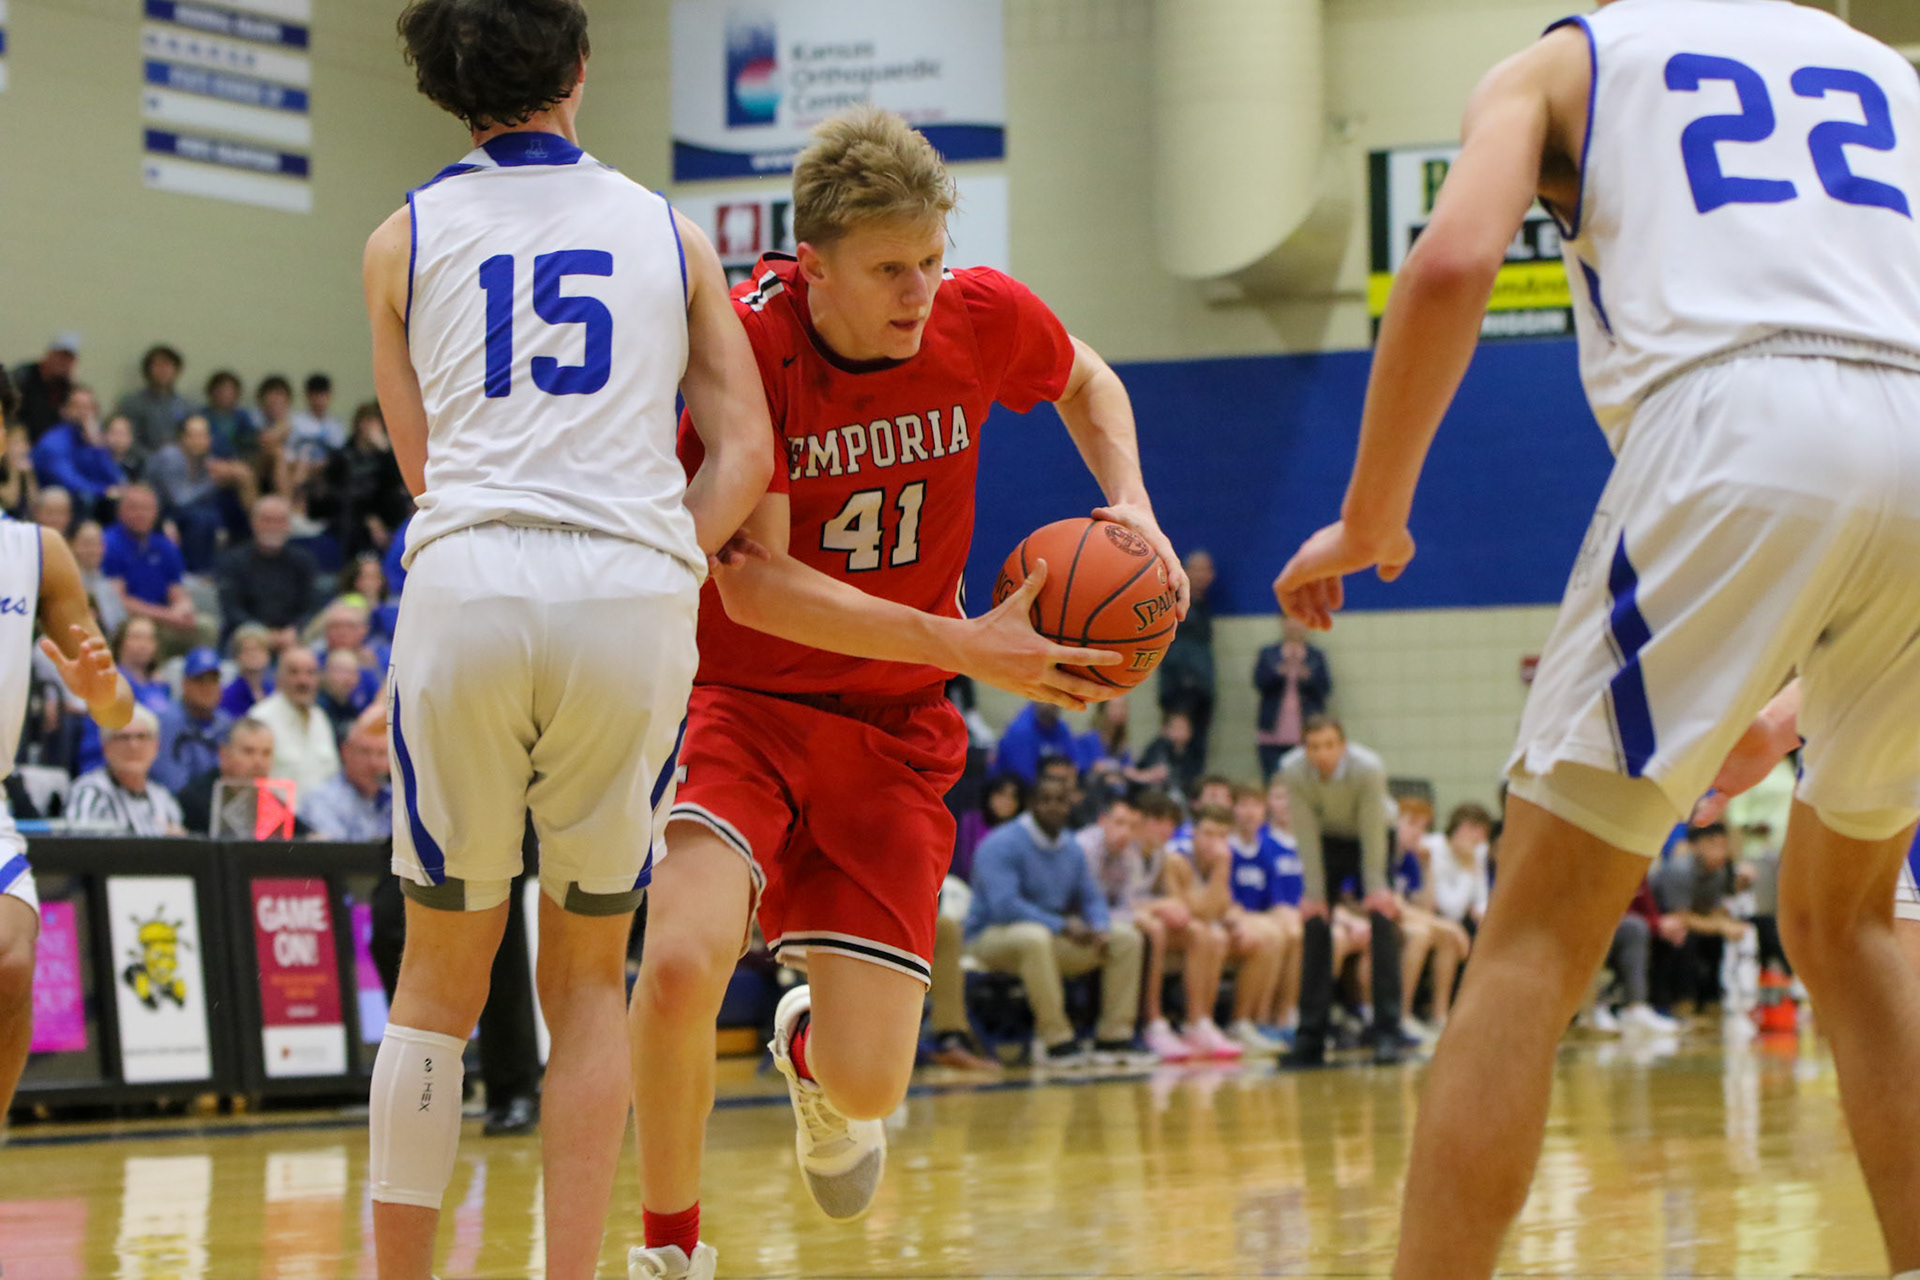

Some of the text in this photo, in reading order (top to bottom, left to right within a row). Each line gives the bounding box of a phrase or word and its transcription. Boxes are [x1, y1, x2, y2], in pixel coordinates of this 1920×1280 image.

[790, 42, 875, 60] Kansas
[1664, 53, 1912, 219] 22
[480, 249, 613, 398] 15
[788, 405, 970, 481] EMPORIA
[819, 479, 927, 573] 41
[256, 895, 328, 932] GAME
[418, 1082, 434, 1112] HEX
